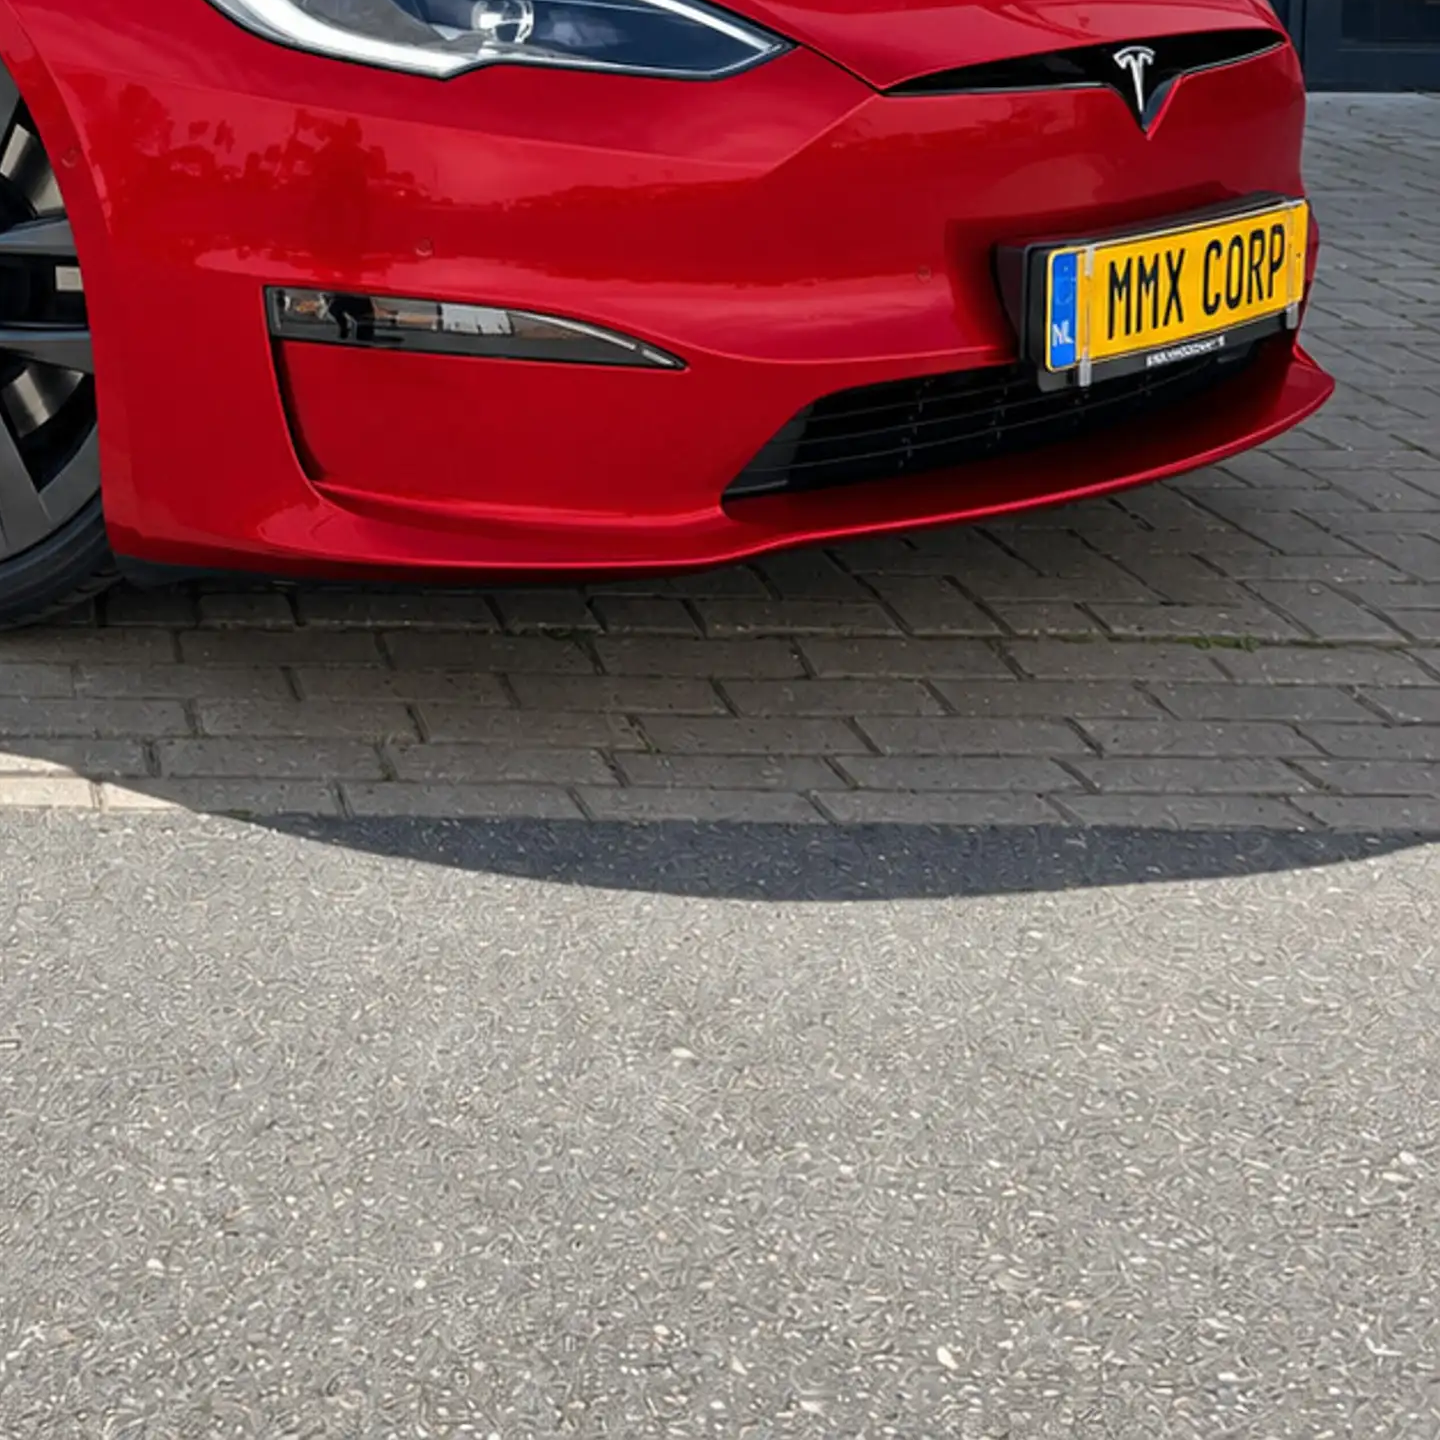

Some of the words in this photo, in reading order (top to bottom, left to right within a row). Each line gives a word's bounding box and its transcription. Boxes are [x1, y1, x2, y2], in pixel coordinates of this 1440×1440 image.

[1107, 247, 1186, 340] MMX
[1202, 223, 1286, 316] CORP
[1051, 319, 1074, 348] NL
